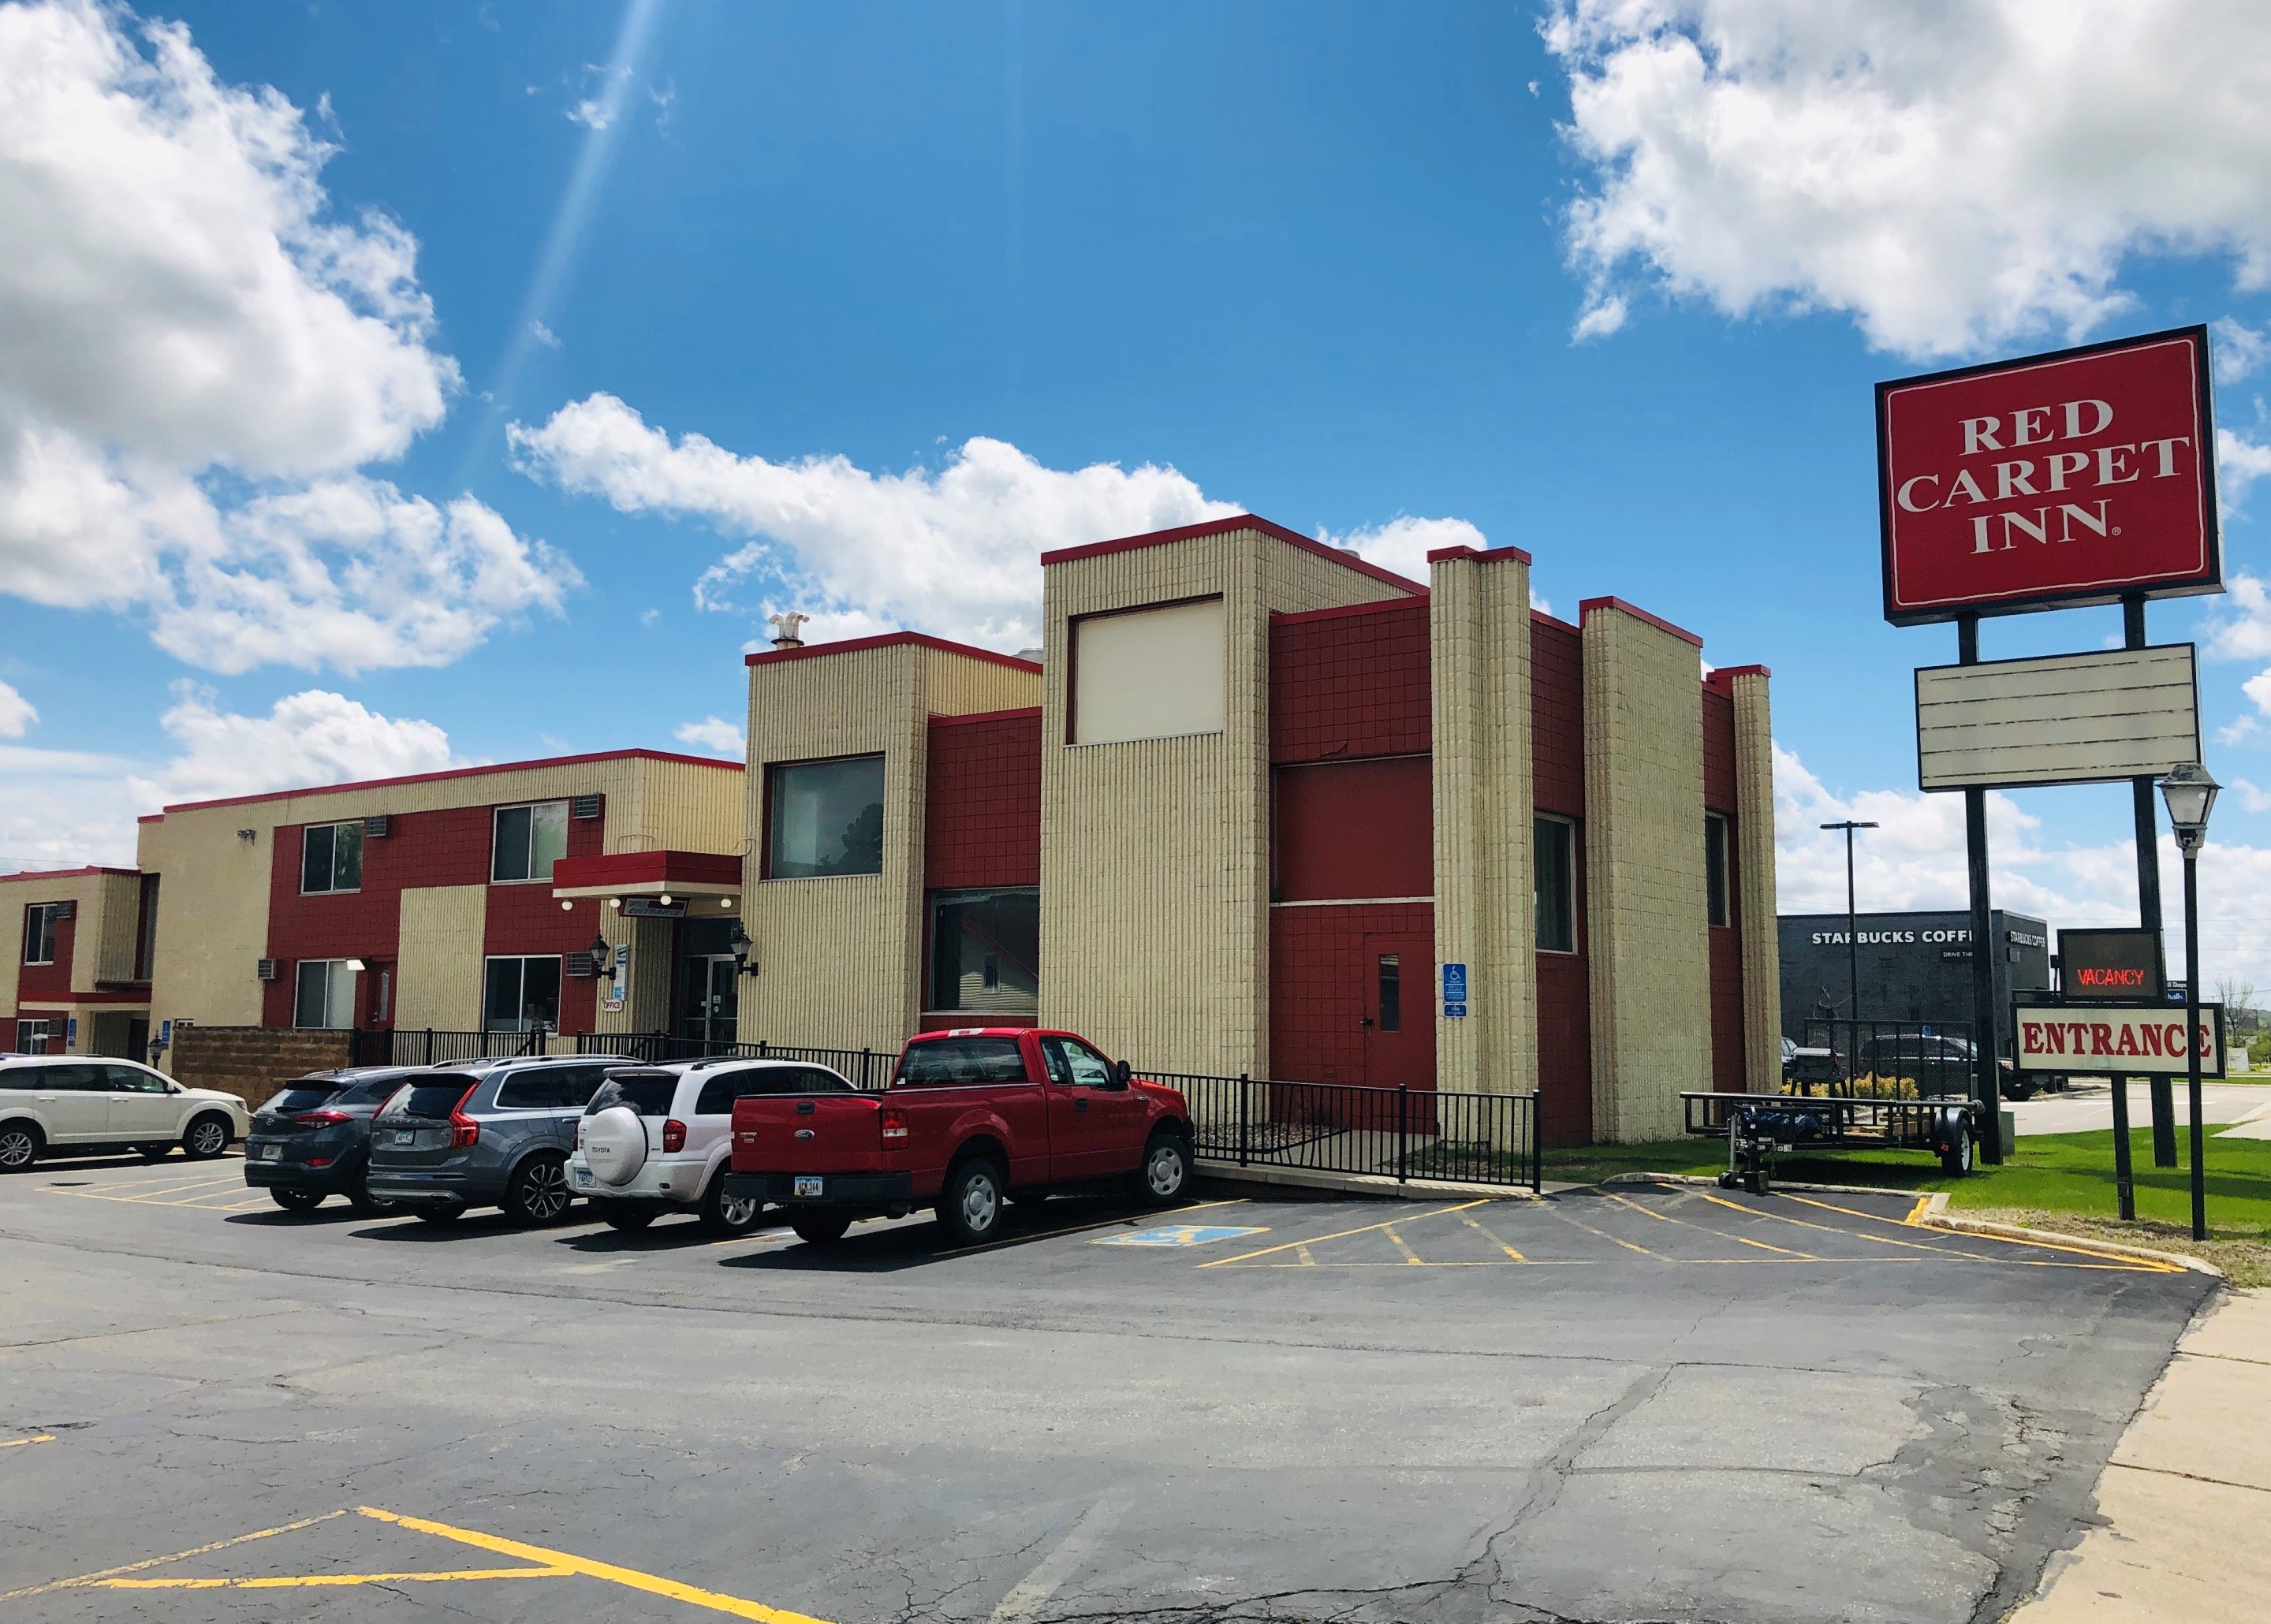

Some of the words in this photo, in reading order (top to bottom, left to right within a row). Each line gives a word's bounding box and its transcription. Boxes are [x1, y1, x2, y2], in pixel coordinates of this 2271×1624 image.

[1959, 399, 2113, 456] RED
[1897, 436, 2190, 512] CARPET
[1922, 930, 1973, 943] COFF
[2077, 968, 2145, 986] VACANCY
[2022, 1022, 2212, 1058] ENTRANCE
